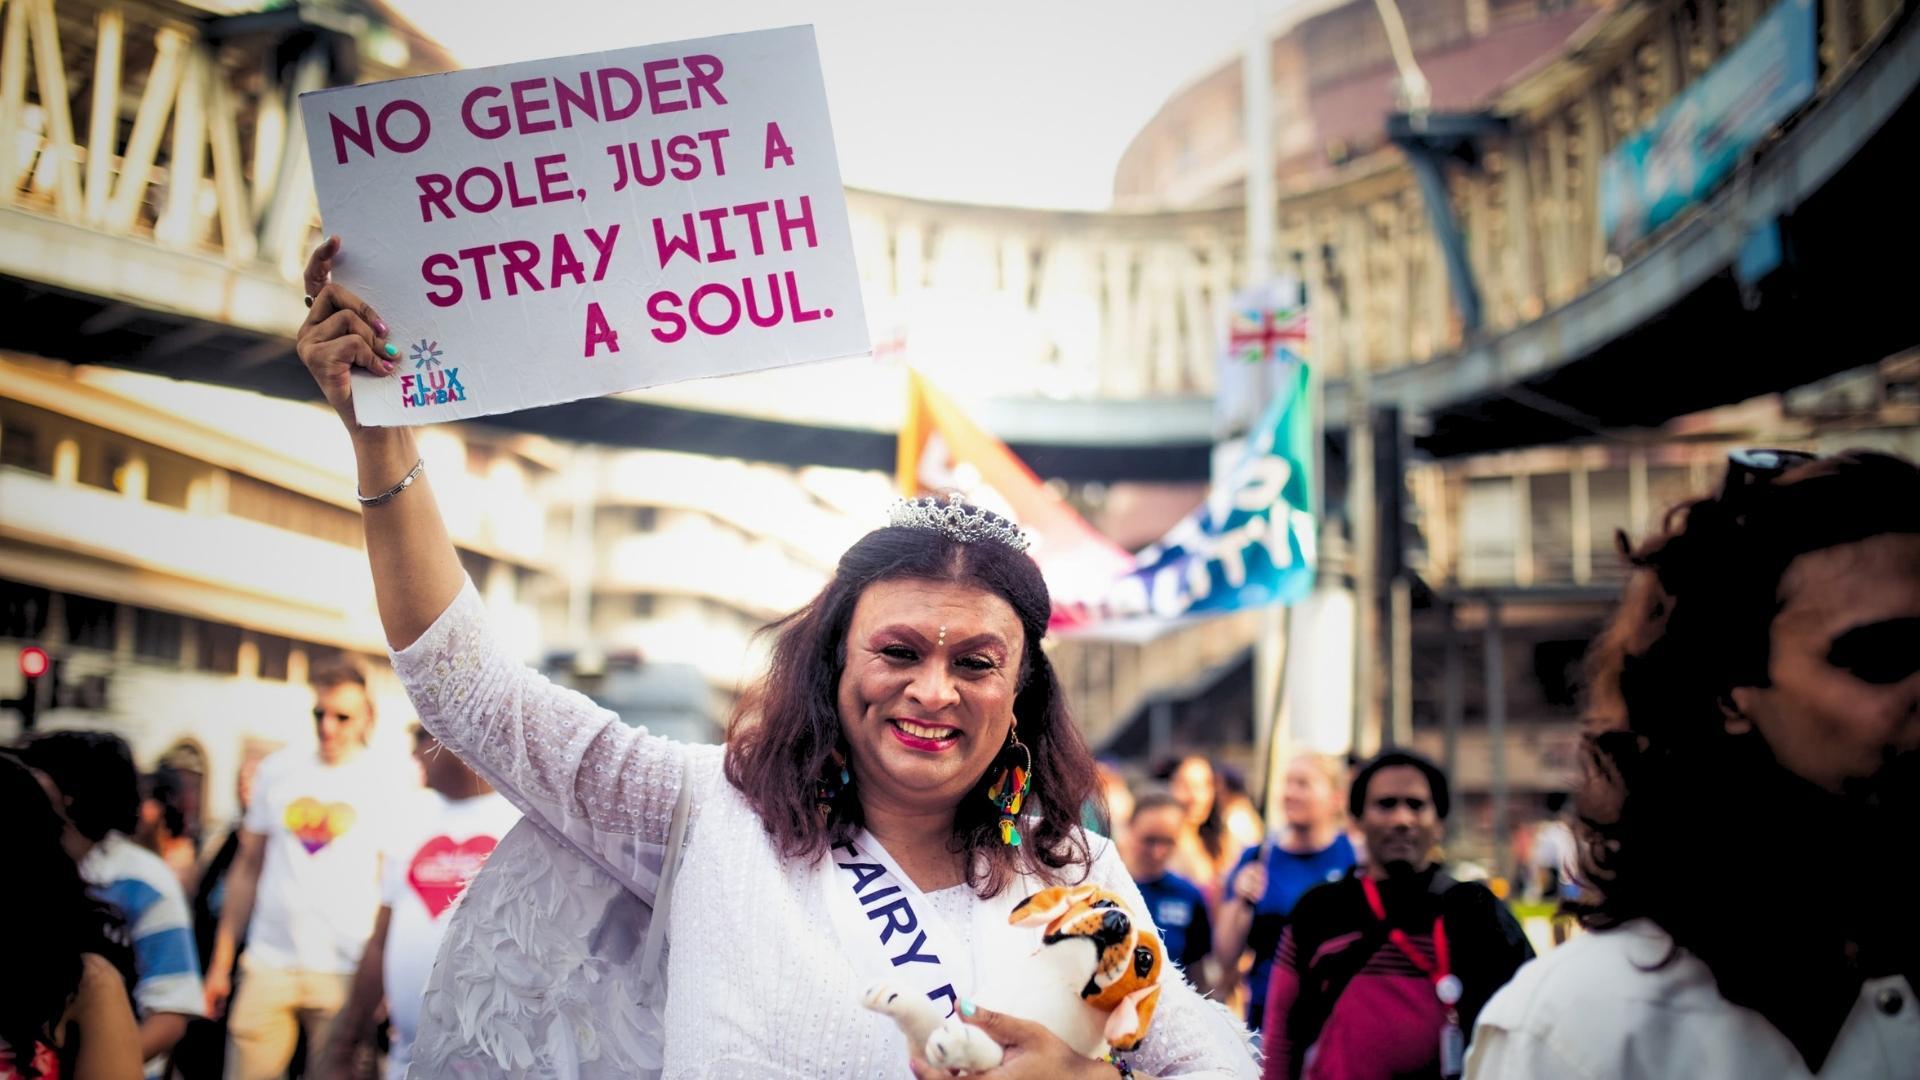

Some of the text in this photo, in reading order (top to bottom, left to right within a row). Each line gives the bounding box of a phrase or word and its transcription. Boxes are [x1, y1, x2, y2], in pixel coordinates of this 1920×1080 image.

[329, 54, 727, 163] NO GENDER
[415, 121, 795, 222] ROLE, JUST A
[421, 195, 818, 308] STRAY WITH
[583, 271, 834, 359] A SOUL.
[400, 367, 461, 394] FLUX
[402, 386, 466, 408] MUMBAI
